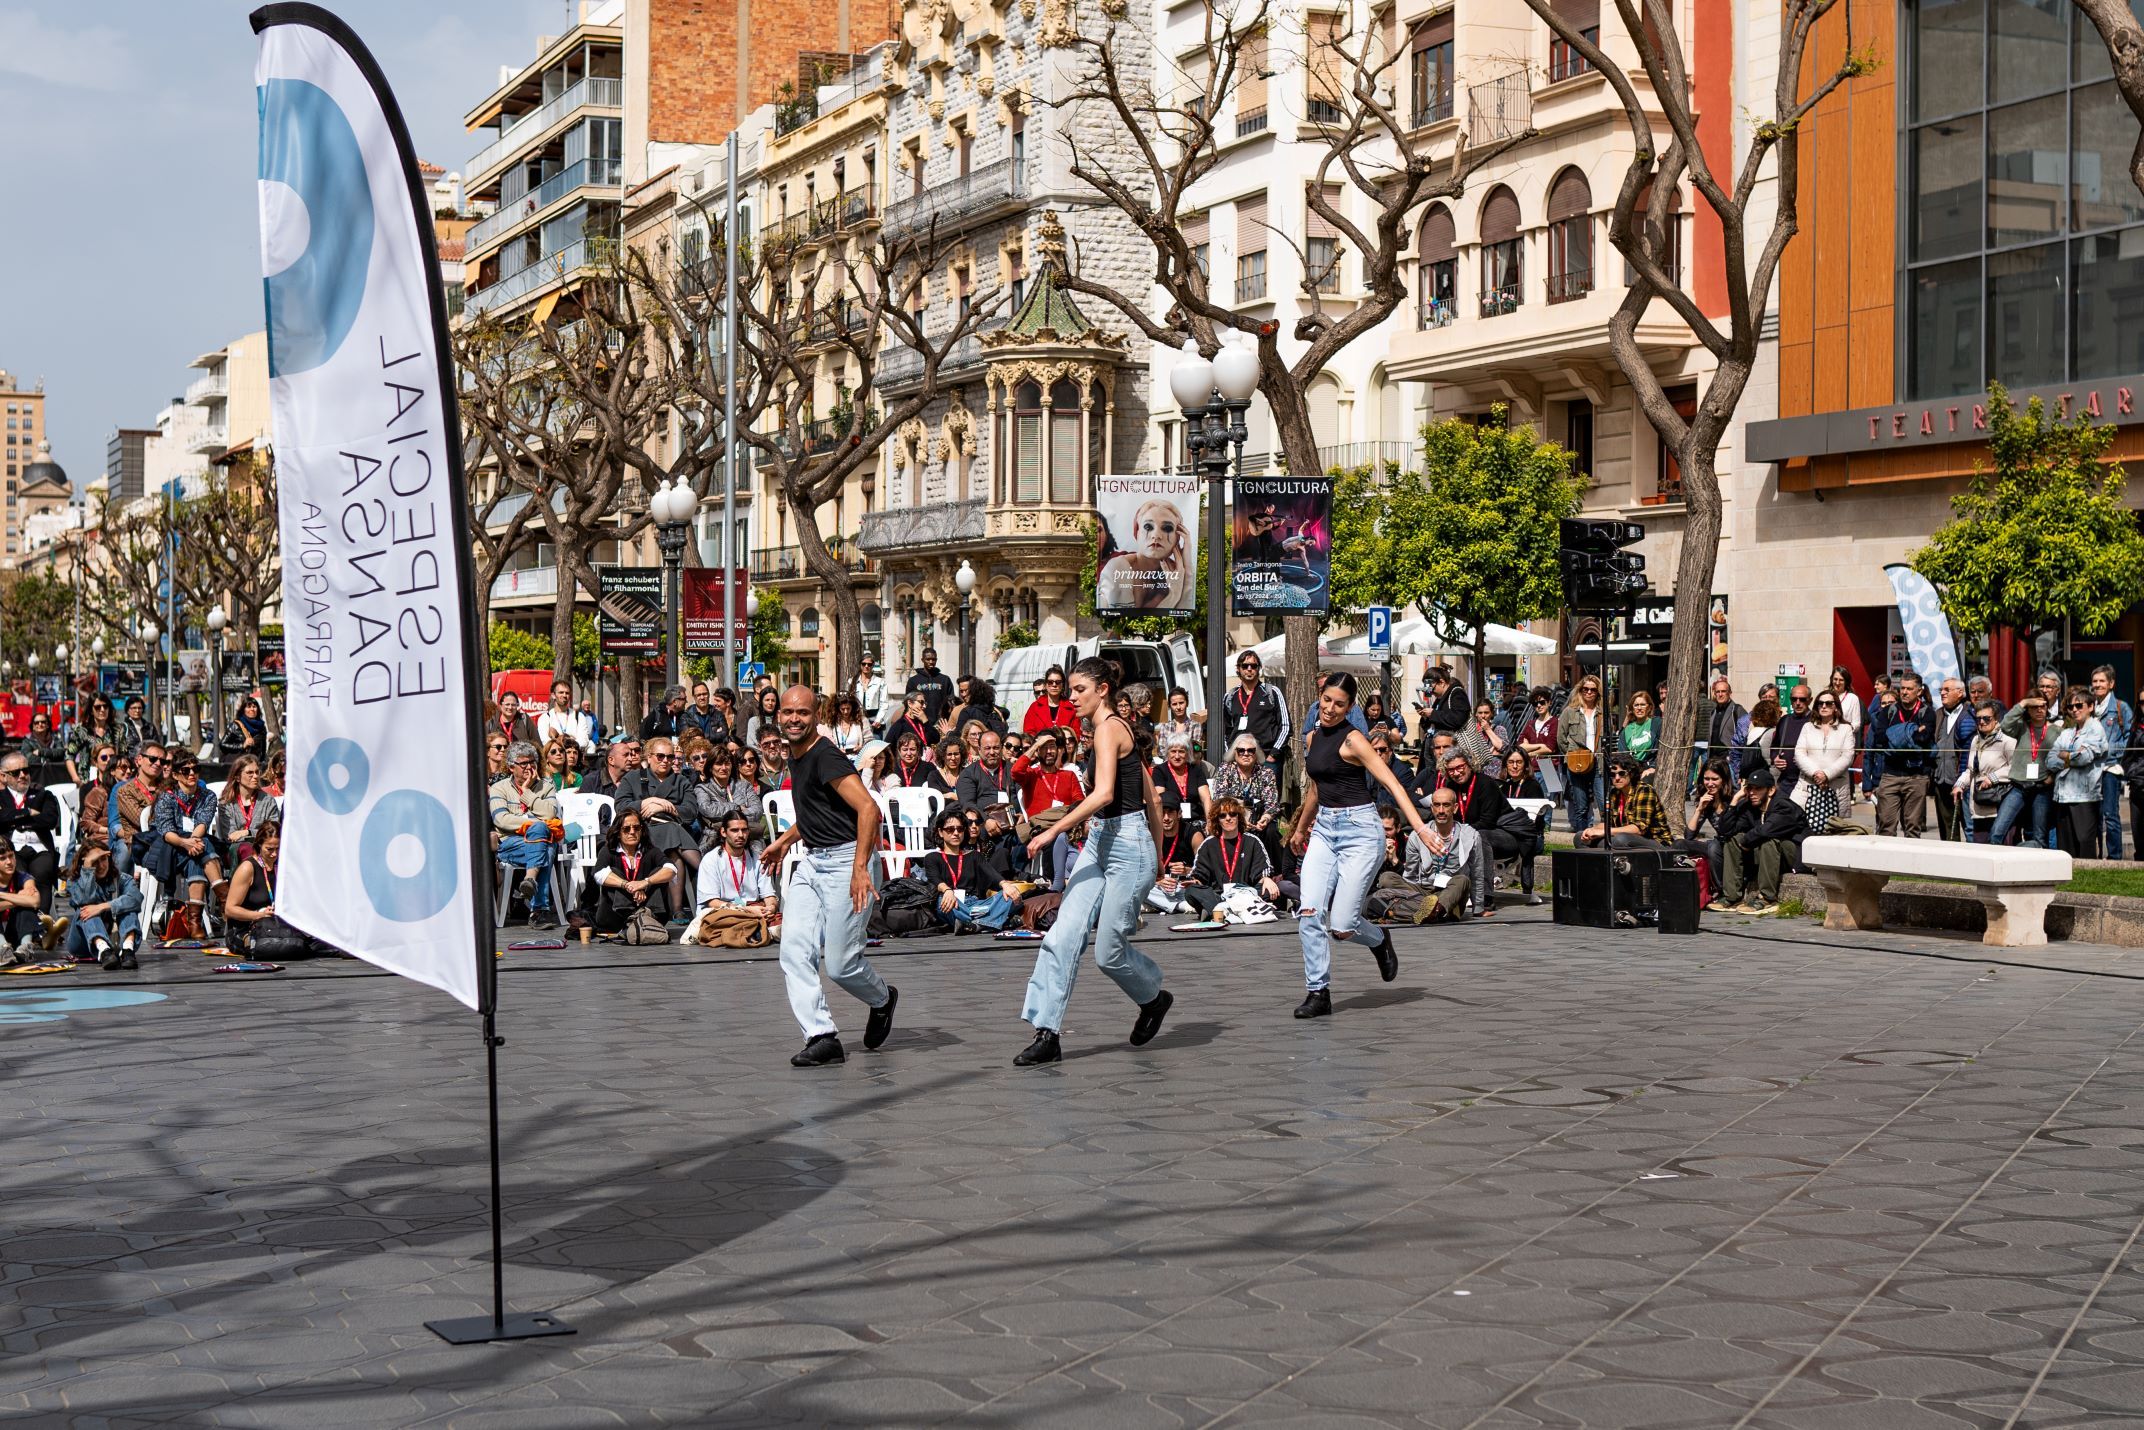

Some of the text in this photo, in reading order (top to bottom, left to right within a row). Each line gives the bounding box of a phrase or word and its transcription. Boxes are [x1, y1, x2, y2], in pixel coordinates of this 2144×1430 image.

[1867, 400, 2017, 441] TEATR
[1101, 480, 1196, 494] TGNCULTURA
[1236, 481, 1330, 494] TGNCULTURA
[602, 575, 660, 583] franz schubert
[1114, 566, 1180, 583] primavera
[1236, 570, 1278, 583] ÓRBITA
[614, 584, 660, 592] filharmonia
[1250, 583, 1263, 591] del
[1648, 606, 1675, 624] Caf
[1372, 611, 1386, 644] P
[688, 640, 741, 648] LA VANGUAA
